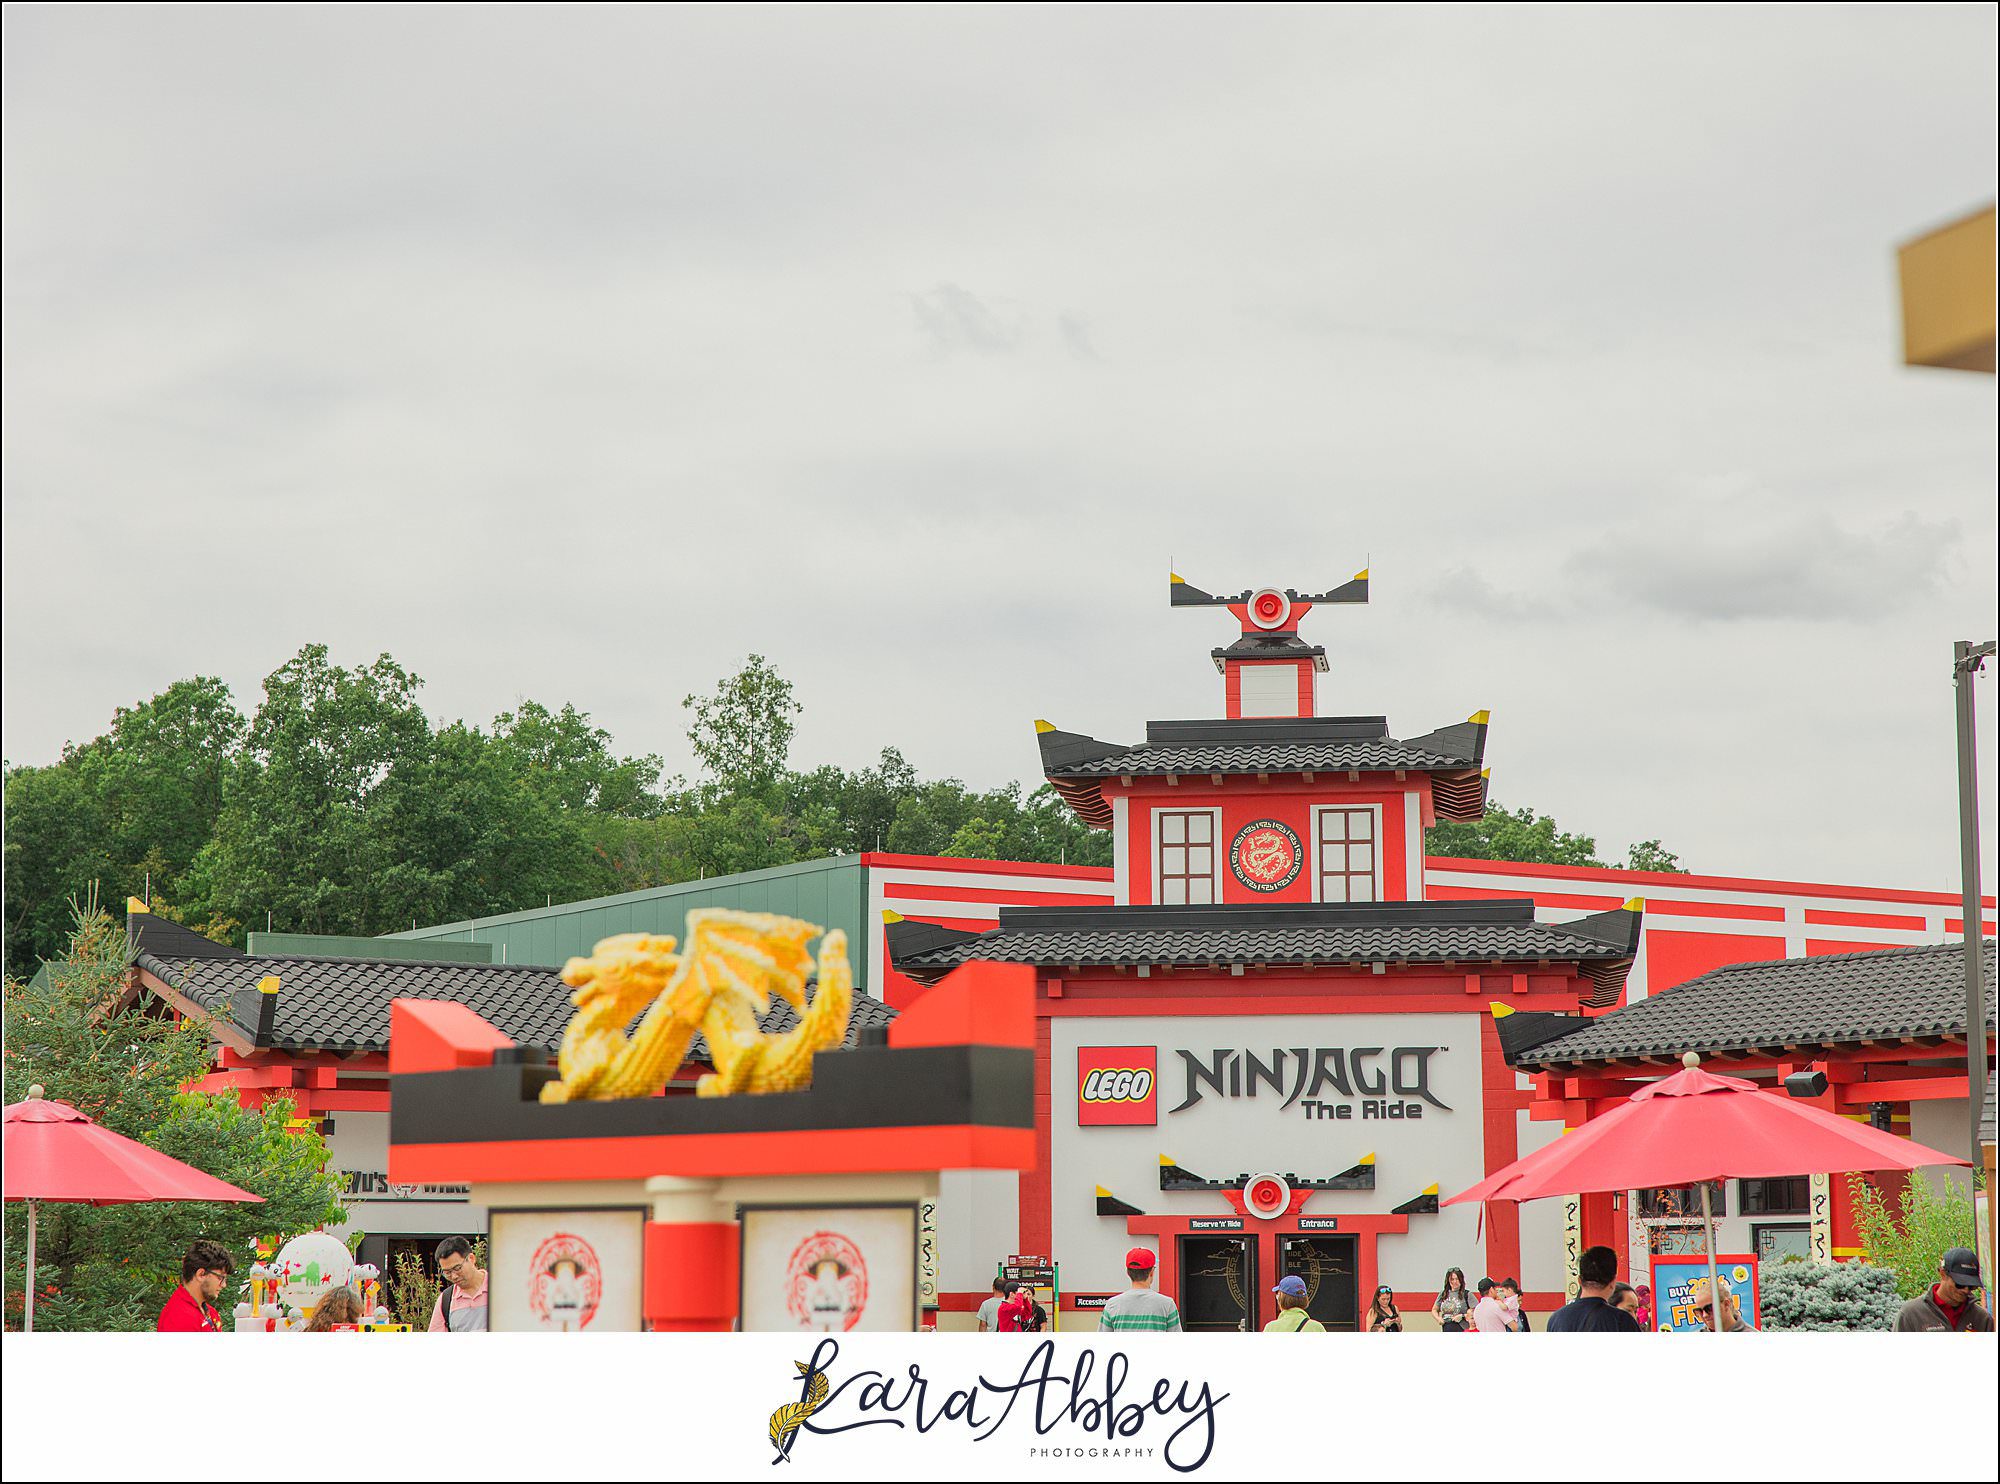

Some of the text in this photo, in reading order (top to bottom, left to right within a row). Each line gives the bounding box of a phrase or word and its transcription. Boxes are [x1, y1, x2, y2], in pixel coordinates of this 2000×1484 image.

[1083, 1070, 1152, 1101] LEGO
[1168, 1047, 1453, 1114] NINJAGO
[1301, 1100, 1423, 1120] The Ride
[1192, 1220, 1218, 1228] Reserve
[1227, 1220, 1241, 1228] Ride
[1301, 1219, 1335, 1228] Entrance
[1669, 1286, 1690, 1298] BUY
